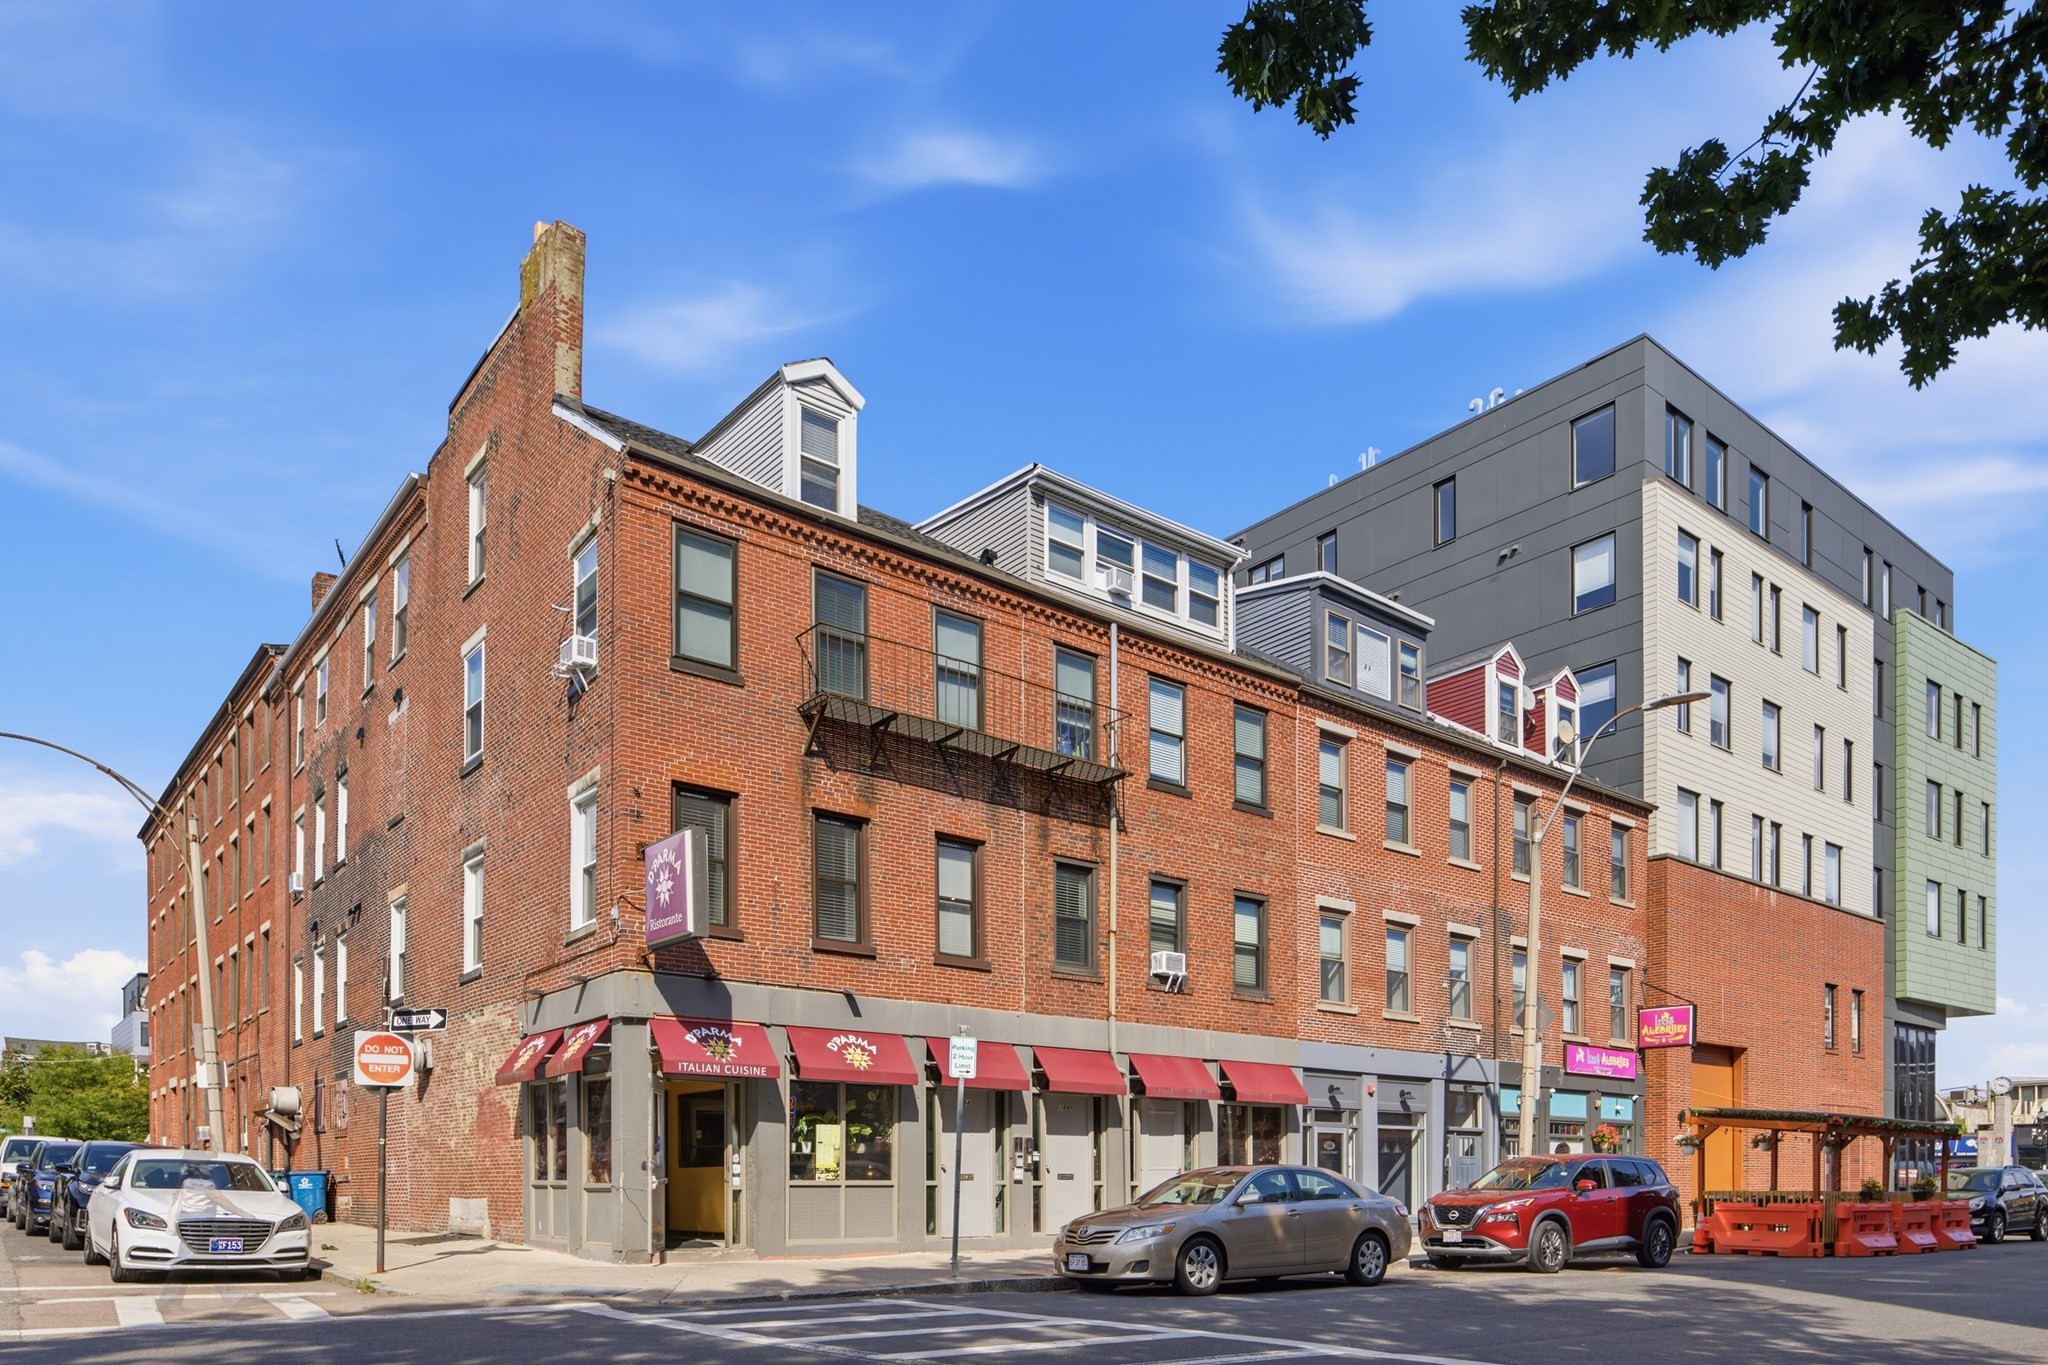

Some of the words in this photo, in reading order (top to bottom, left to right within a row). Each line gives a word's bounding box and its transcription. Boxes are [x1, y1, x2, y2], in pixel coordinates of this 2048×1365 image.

[647, 848, 682, 885] D'PARMA
[649, 912, 683, 931] Ristorante
[396, 1016, 413, 1026] ONE
[415, 1015, 431, 1024] WAY
[684, 1027, 743, 1047] D'PARMA
[826, 1034, 877, 1055] D'PARMA
[364, 1045, 380, 1053] DO
[384, 1046, 404, 1054] NOT
[368, 1065, 401, 1073] ENTER
[678, 1062, 720, 1073] ITALIAN
[724, 1065, 767, 1076] CUISINE
